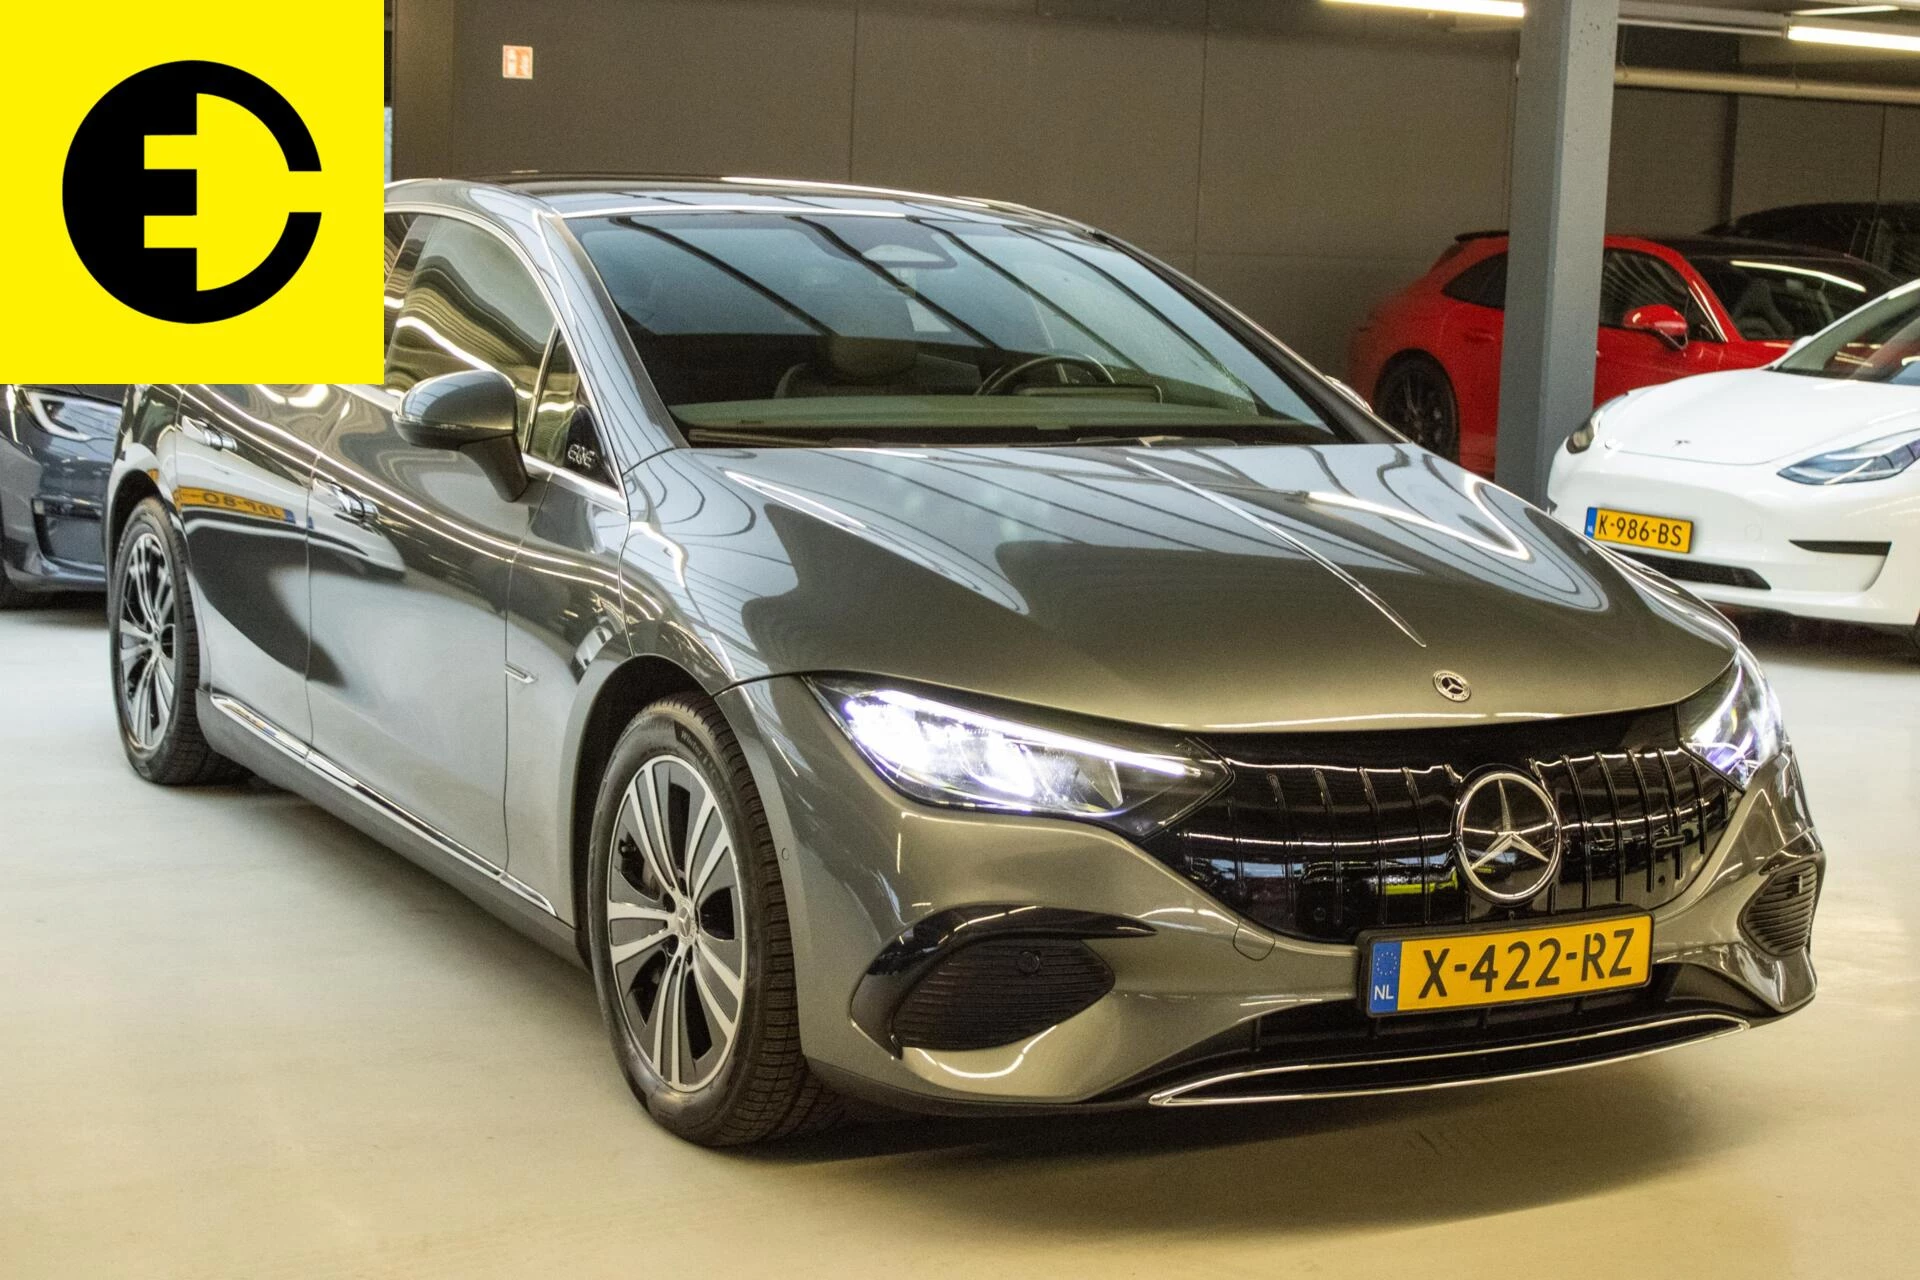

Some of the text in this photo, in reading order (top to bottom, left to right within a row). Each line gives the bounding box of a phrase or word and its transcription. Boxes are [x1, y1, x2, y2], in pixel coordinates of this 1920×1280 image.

[1598, 515, 1682, 546] K-986-BS
[1418, 928, 1635, 999] X-422-RZ
[1373, 984, 1394, 1001] NL
